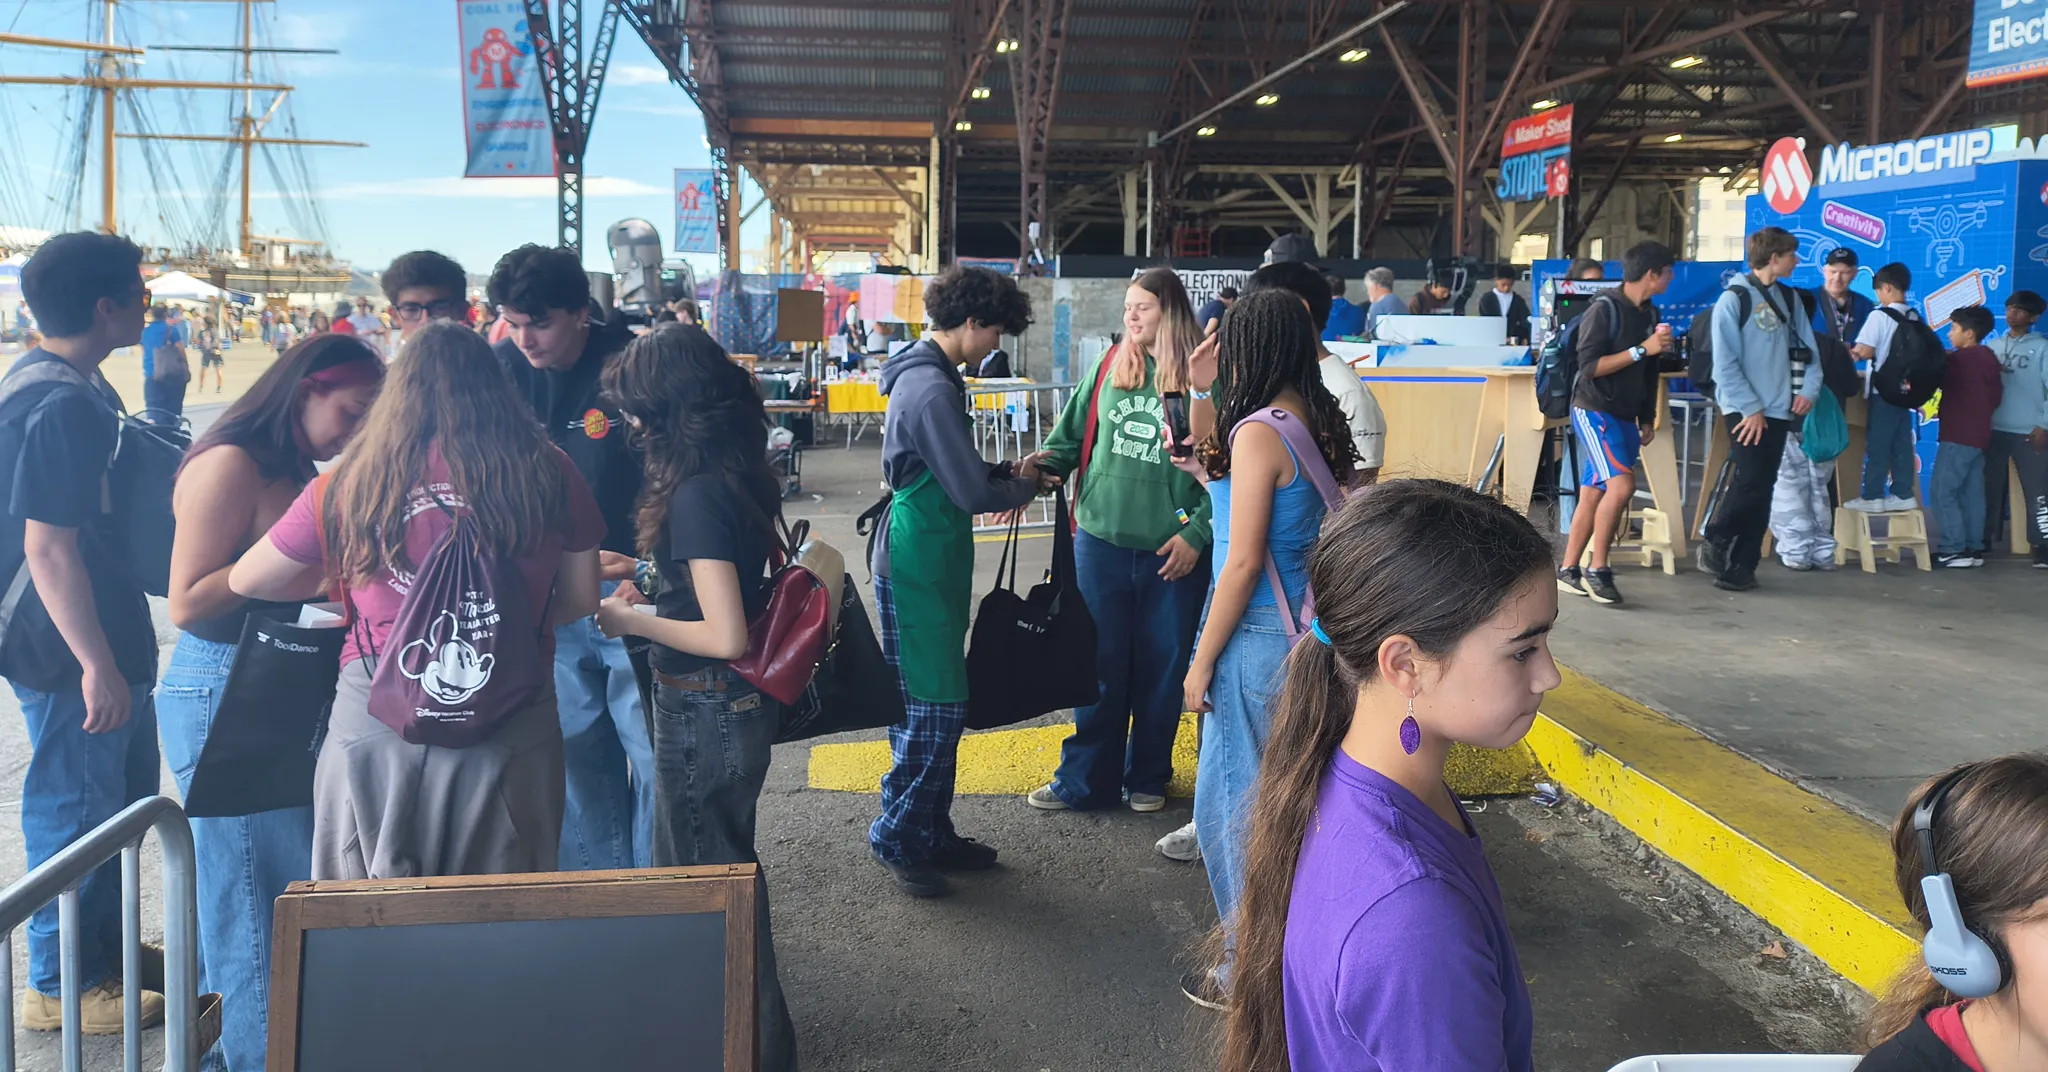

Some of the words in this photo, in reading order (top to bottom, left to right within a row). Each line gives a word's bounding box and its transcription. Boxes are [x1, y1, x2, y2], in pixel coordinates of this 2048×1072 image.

[1515, 125, 1544, 145] Maker
[1497, 147, 1570, 200] STORE
[1819, 130, 1991, 186] MICROCHIP
[1825, 202, 1881, 241] Creativity
[1936, 966, 1967, 976] KOSS
